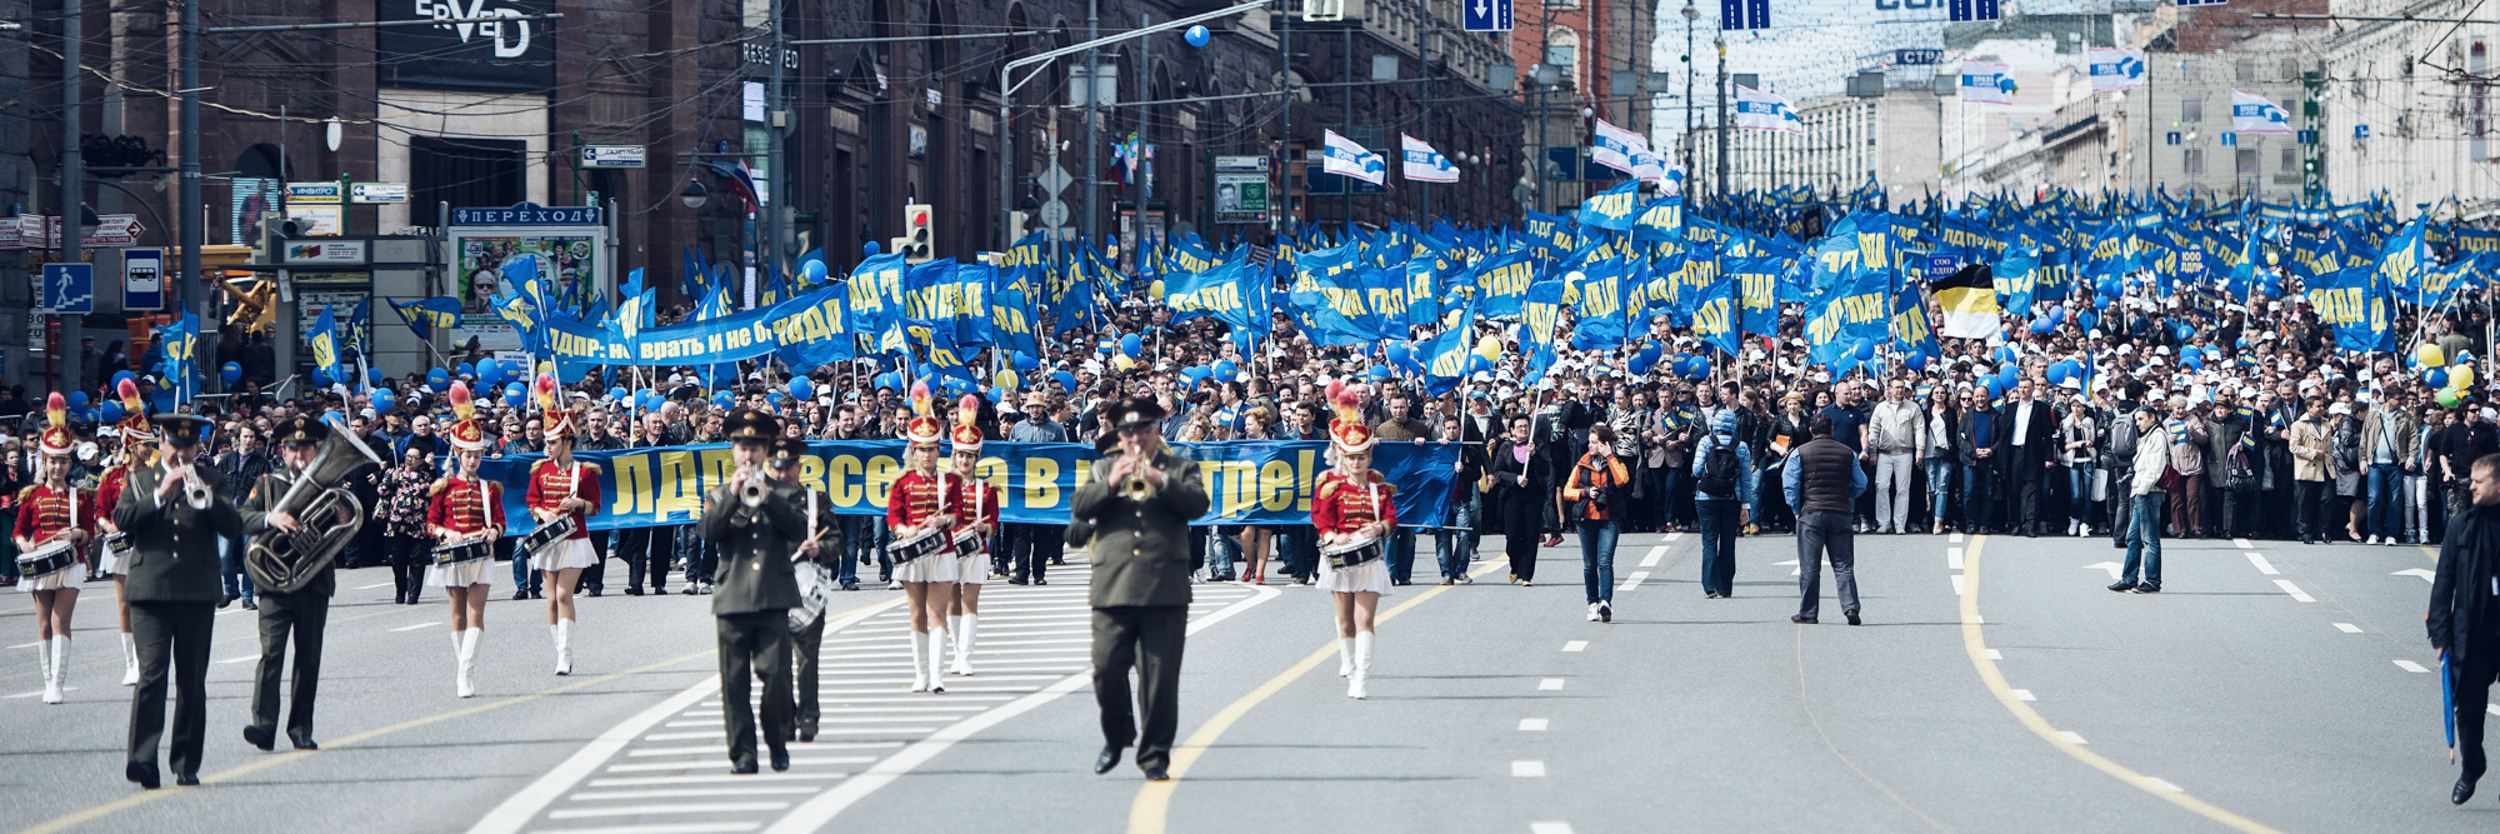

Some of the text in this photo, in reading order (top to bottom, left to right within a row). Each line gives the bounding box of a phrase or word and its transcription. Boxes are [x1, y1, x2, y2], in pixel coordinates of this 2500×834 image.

[743, 42, 799, 69] RESEED
[471, 210, 582, 222] ПЕРЕХОД
[2459, 235, 2500, 255] ЛДП
[2181, 251, 2202, 262] 1000
[1930, 267, 1955, 276] ЛДПР
[2180, 262, 2203, 274] ЛДПР
[640, 337, 705, 360] врать
[726, 326, 752, 350] не
[612, 450, 778, 523] ЛДП
